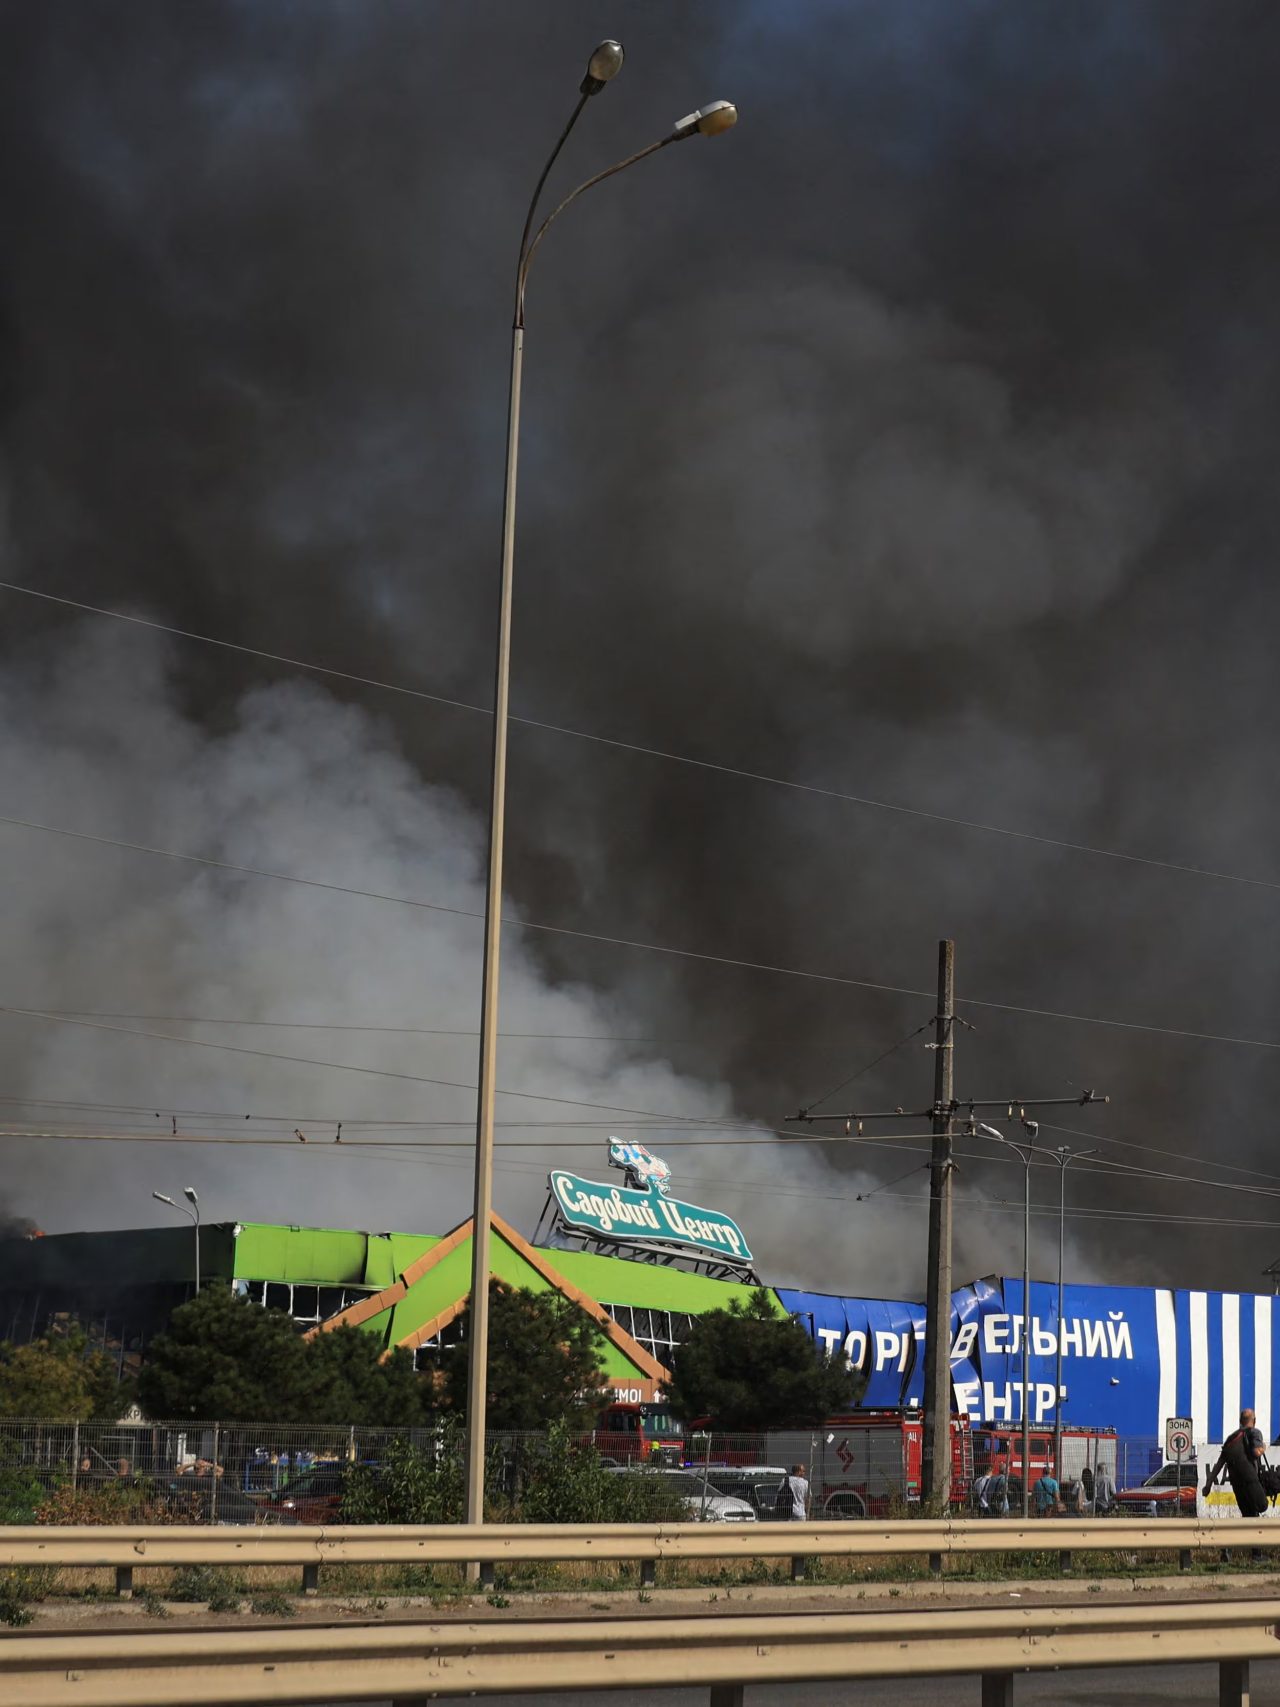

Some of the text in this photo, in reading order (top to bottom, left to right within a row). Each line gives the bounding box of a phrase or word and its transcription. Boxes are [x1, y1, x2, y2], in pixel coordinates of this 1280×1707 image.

[556, 1176, 743, 1256] Садовий Центр
[1169, 1421, 1190, 1429] ЗОНА
